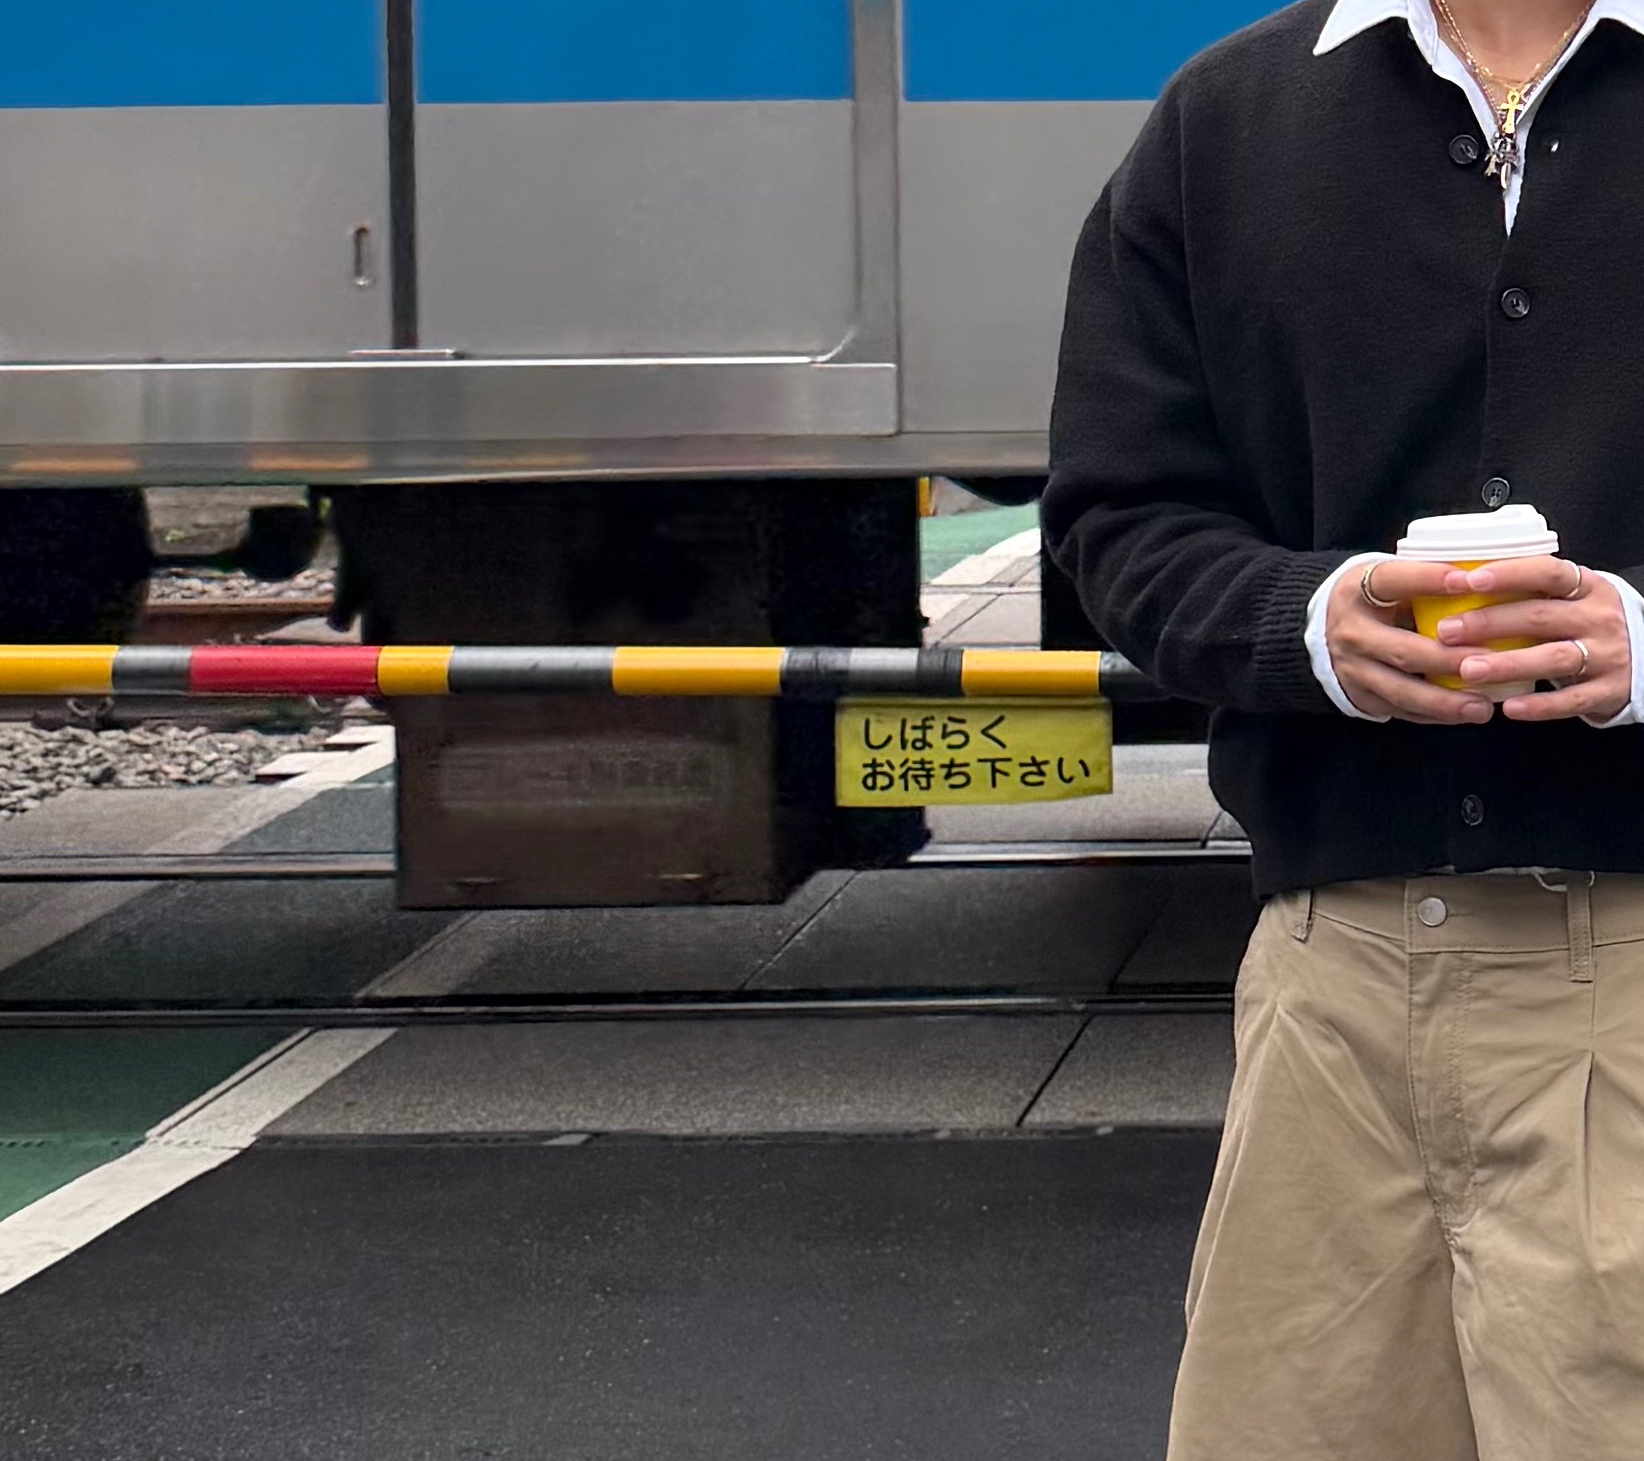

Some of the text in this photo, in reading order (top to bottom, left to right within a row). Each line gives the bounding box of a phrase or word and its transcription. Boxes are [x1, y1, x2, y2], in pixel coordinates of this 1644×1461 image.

[862, 715, 1008, 751] しばらく
[861, 755, 1090, 792] お待ち下さい
